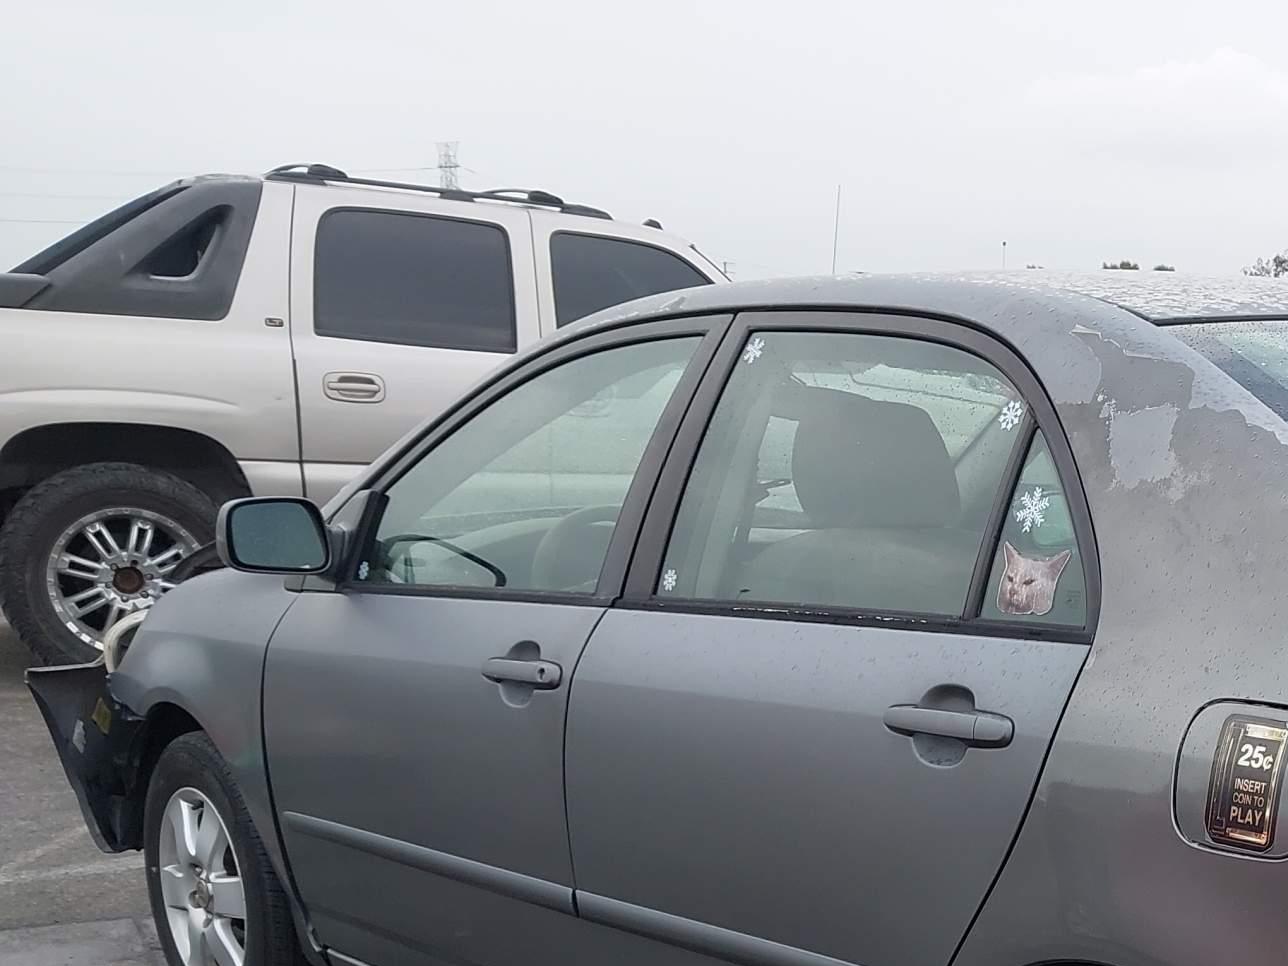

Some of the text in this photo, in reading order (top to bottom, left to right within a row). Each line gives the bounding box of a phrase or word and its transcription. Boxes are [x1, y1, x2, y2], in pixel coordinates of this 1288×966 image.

[1234, 778, 1267, 794] INSERT
[1232, 792, 1265, 808] COIN TO
[1229, 806, 1262, 826] PLAY
